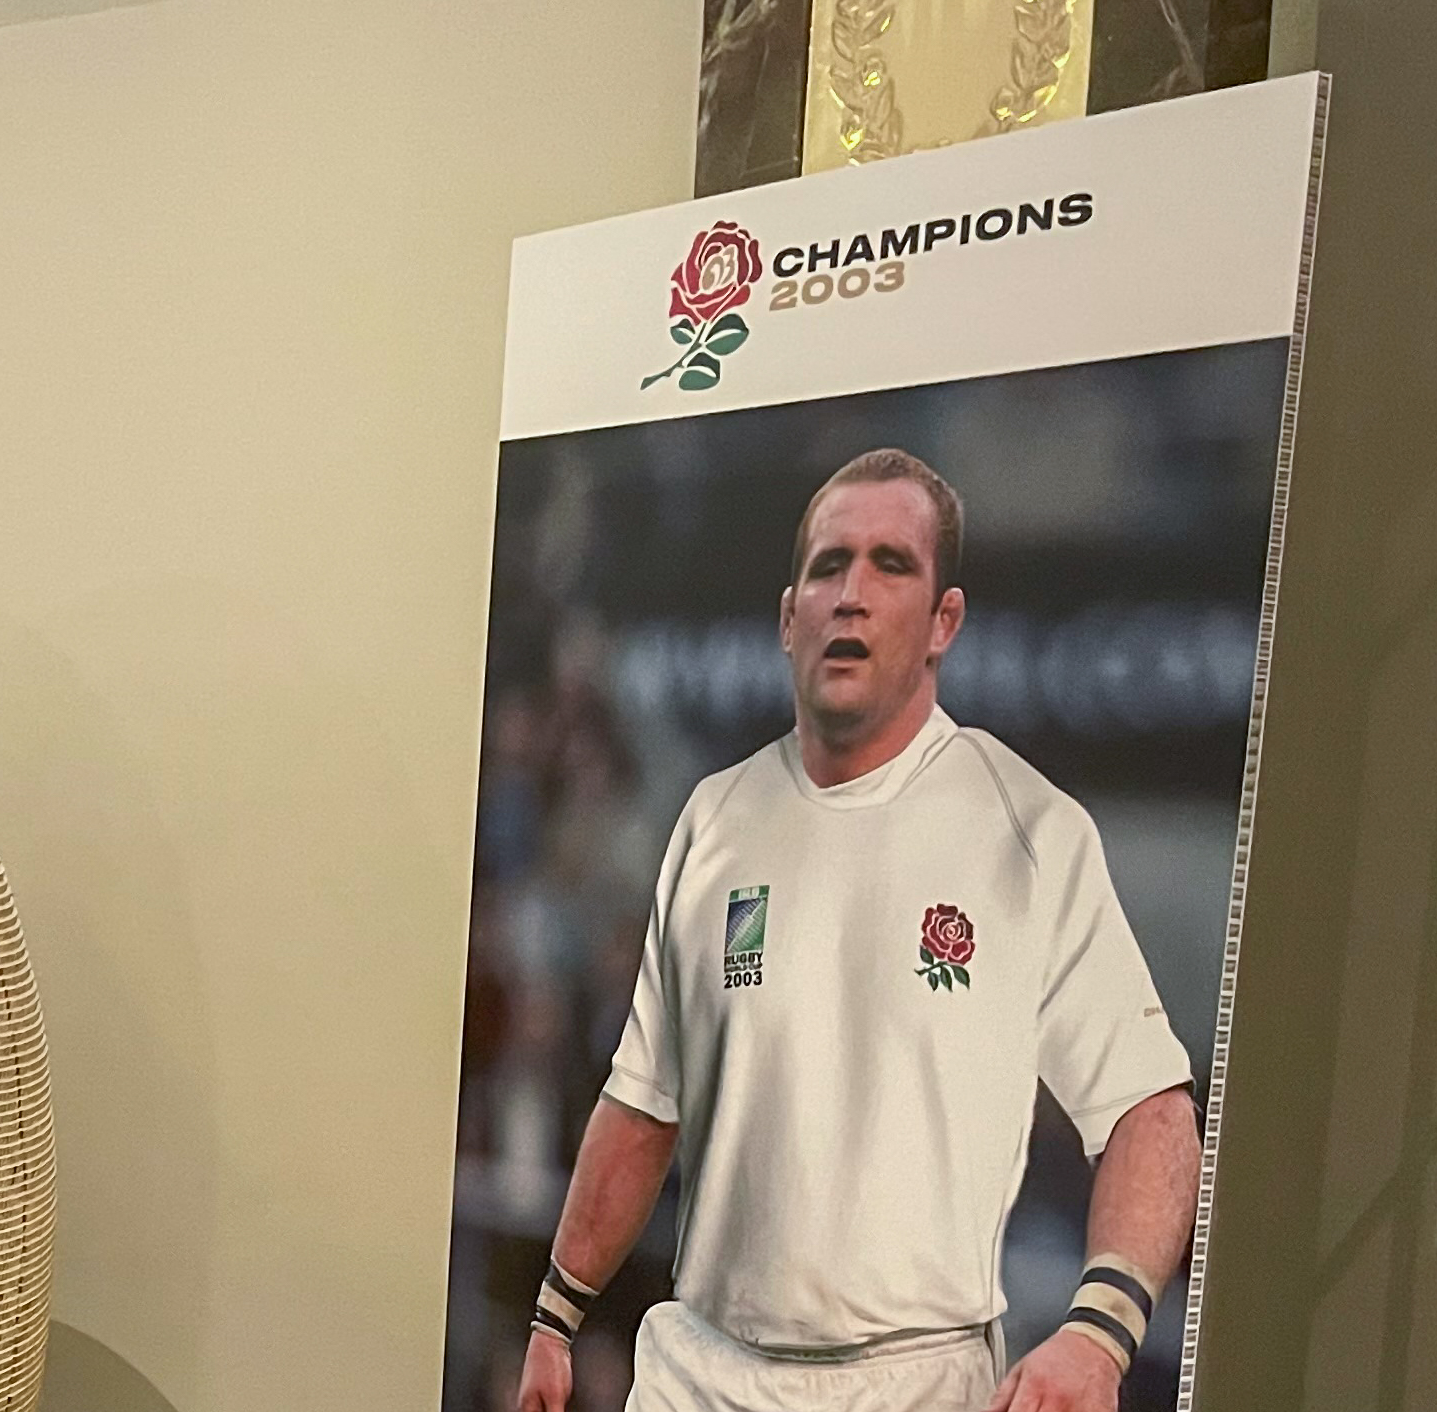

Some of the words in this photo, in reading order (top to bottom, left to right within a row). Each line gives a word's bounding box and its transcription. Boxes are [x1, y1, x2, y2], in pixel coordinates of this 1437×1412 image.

[772, 193, 1093, 278] CHAMPIONS
[768, 261, 905, 312] 2003
[724, 970, 763, 989] 2003
